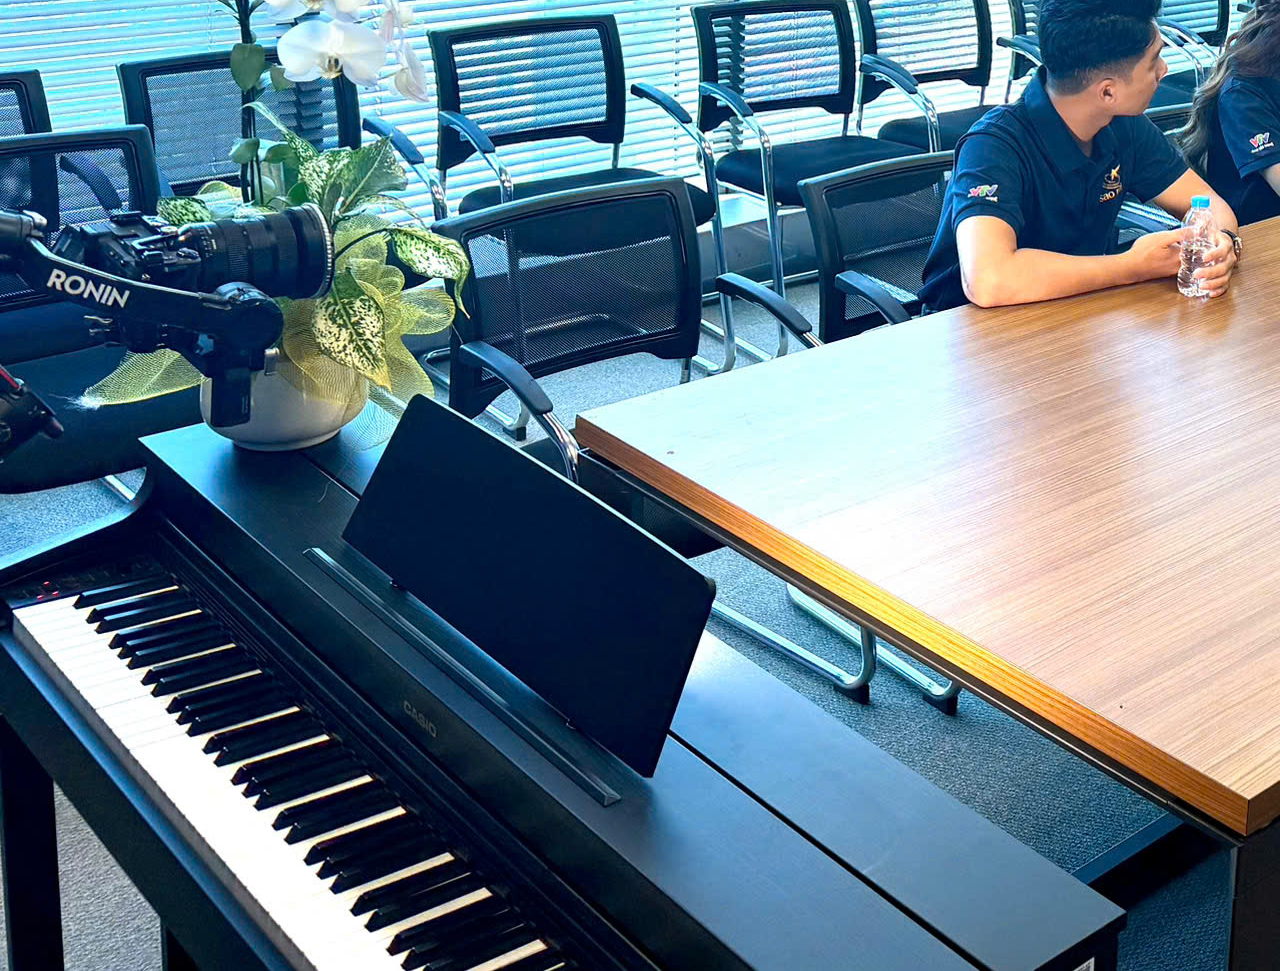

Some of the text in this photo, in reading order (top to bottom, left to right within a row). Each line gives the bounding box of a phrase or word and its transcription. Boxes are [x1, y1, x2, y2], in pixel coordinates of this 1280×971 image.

[1249, 132, 1270, 148] VTV
[969, 184, 999, 197] VTV
[46, 268, 130, 308] RONIN
[403, 700, 437, 738] CASIO
